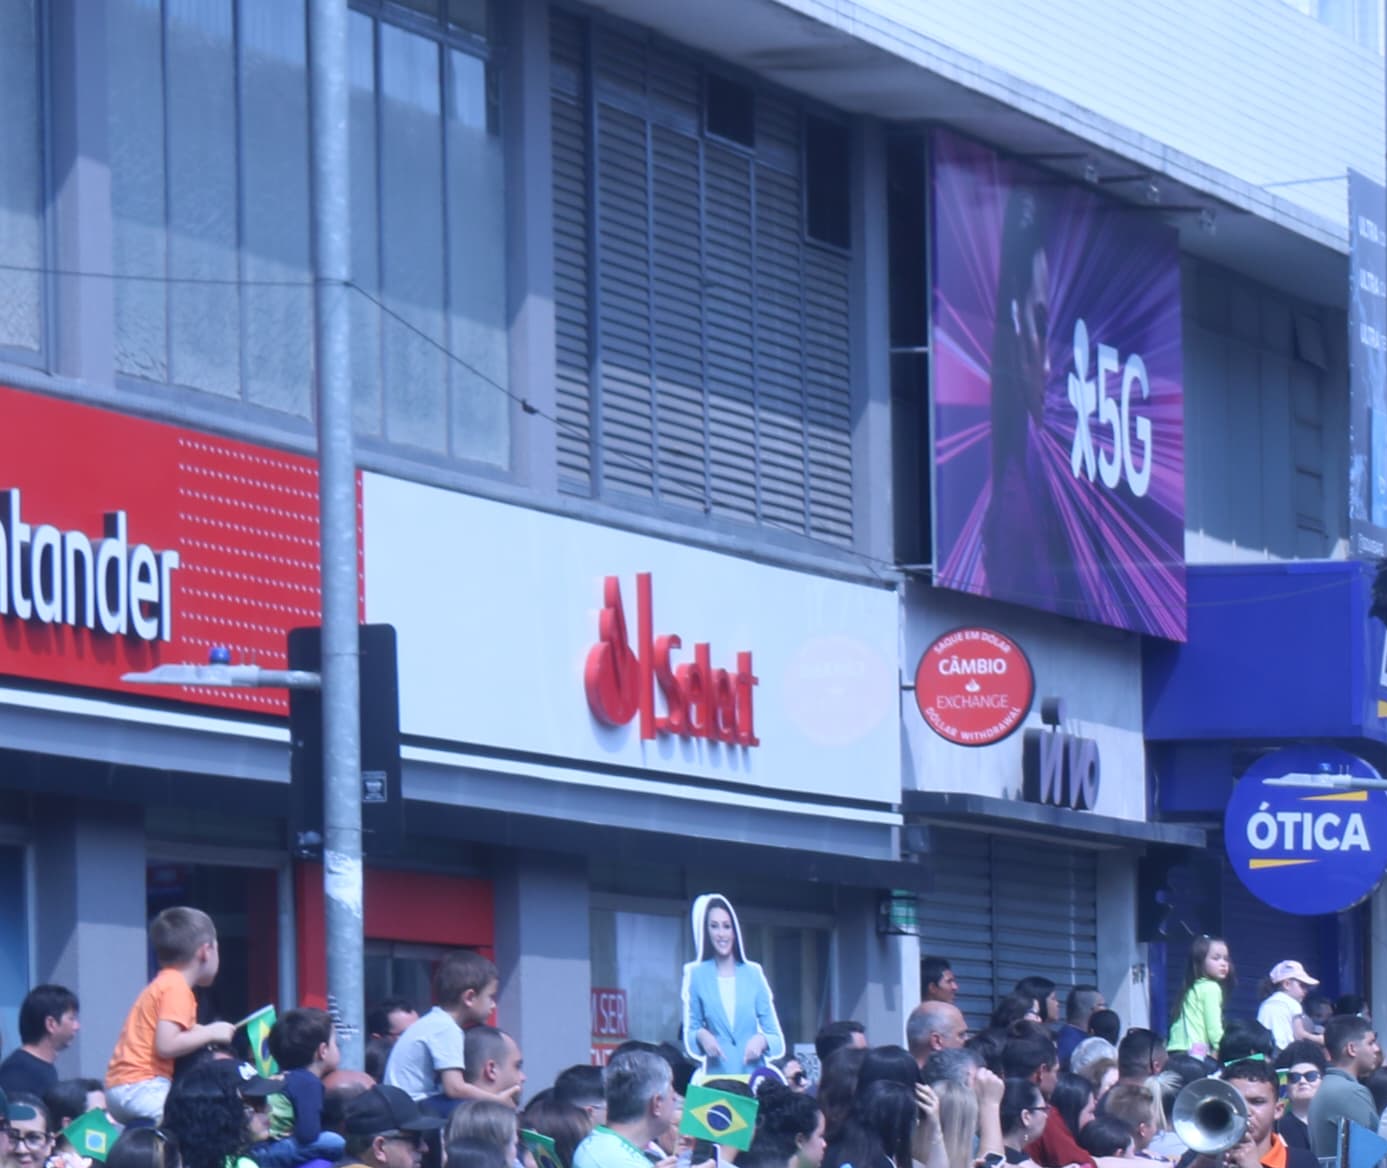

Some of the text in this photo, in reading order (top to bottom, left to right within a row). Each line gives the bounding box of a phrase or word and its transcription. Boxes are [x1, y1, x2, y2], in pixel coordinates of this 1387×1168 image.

[1098, 343, 1151, 496] 5G
[965, 630, 980, 641] EM
[938, 656, 1008, 675] CÂMBIO
[655, 634, 760, 747] Select
[936, 694, 1009, 709] EXCHANGE
[925, 706, 1022, 740] DOLLAR WITHDRAWAL
[1246, 802, 1371, 852] ÓTICA
